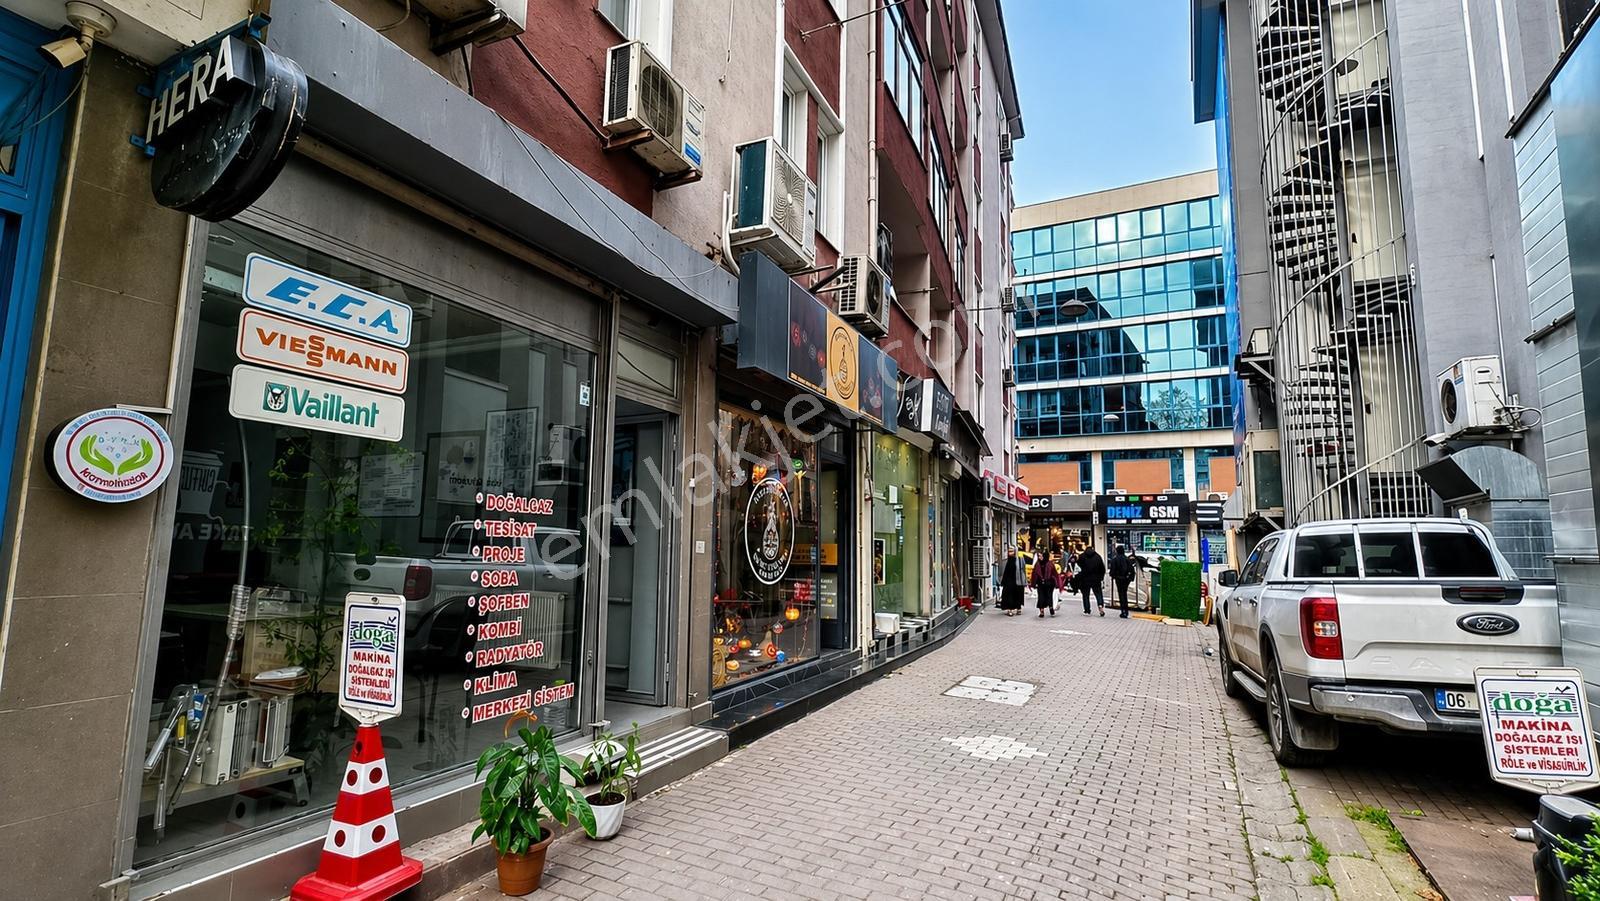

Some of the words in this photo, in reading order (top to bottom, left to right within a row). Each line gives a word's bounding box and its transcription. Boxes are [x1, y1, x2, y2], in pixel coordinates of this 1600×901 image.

[146, 35, 234, 144] HERA
[256, 327, 397, 376] VIESSMANN
[291, 387, 379, 428] Vaillant
[486, 493, 553, 514] DOĞALGAZ
[1107, 504, 1142, 518] DENİZ
[1149, 505, 1179, 518] GSM
[485, 519, 536, 538] TESİSAT
[483, 547, 525, 563] PROJE
[481, 570, 518, 587] SOBA
[479, 593, 530, 615] ŞOFBEN
[478, 618, 522, 640] KOMBİ
[1476, 617, 1504, 630] Ford
[353, 651, 391, 664] MAKİNA
[476, 640, 543, 667] RADYATÖR
[474, 671, 517, 695] KLİMA
[472, 690, 531, 723] MERKEZİ
[534, 683, 574, 707] SİSTEM
[1446, 693, 1466, 708] 06
[1493, 692, 1572, 716] doğa
[1501, 718, 1572, 731] MAKİNA
[1495, 731, 1563, 744] DOĞALGAZ
[1501, 755, 1525, 769] RÖLE
[1527, 762, 1537, 770] ve
